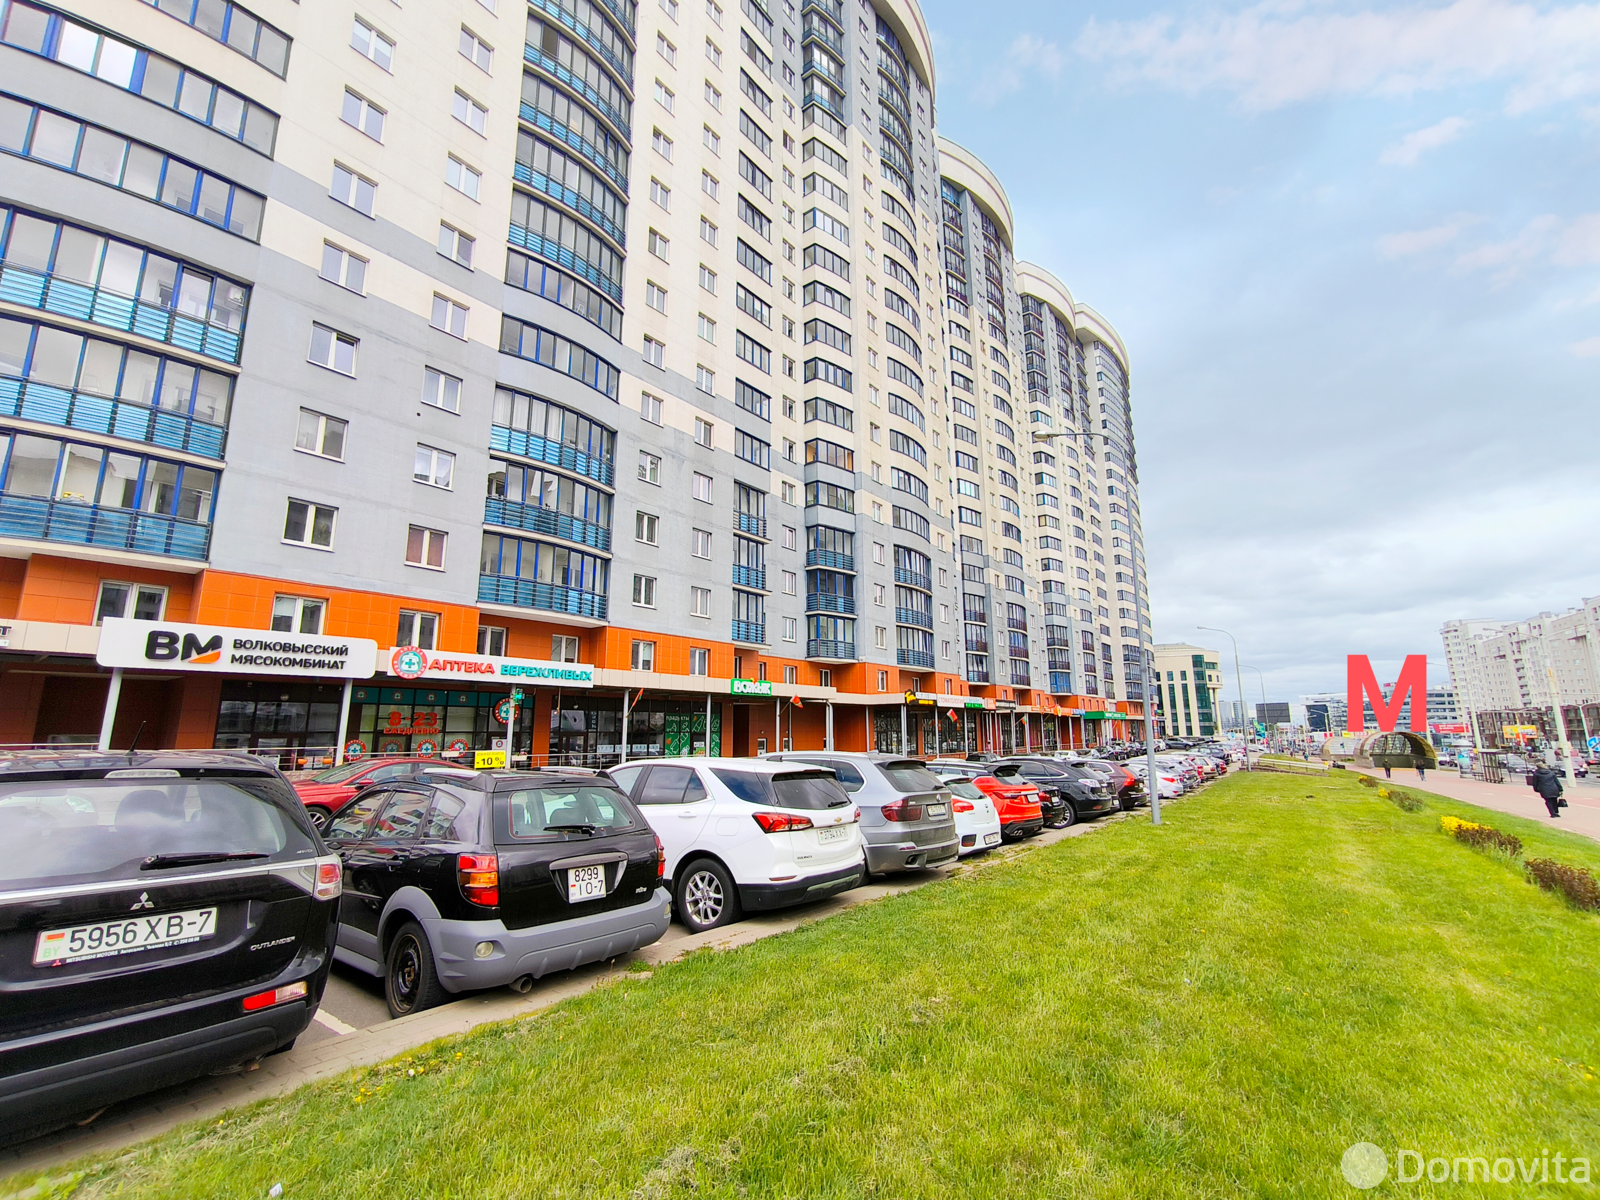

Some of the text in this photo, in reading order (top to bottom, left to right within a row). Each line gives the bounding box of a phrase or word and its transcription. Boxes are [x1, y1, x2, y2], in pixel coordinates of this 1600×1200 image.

[233, 638, 349, 656] ВОЛКОВЫССКИЙ
[230, 655, 346, 670] МЯСОКОМБИНАТ
[428, 659, 593, 682] АПТЕКА БЕРЕЖЛИВЫХ
[383, 727, 440, 735] ЕЖЕДНЕВНО
[574, 866, 599, 882] 8299
[69, 922, 138, 953] 5956
[250, 936, 296, 951] OUTLANDER
[42, 946, 61, 959] BY
[66, 953, 96, 964] MITSUBISHI
[96, 950, 118, 959] MOTORS
